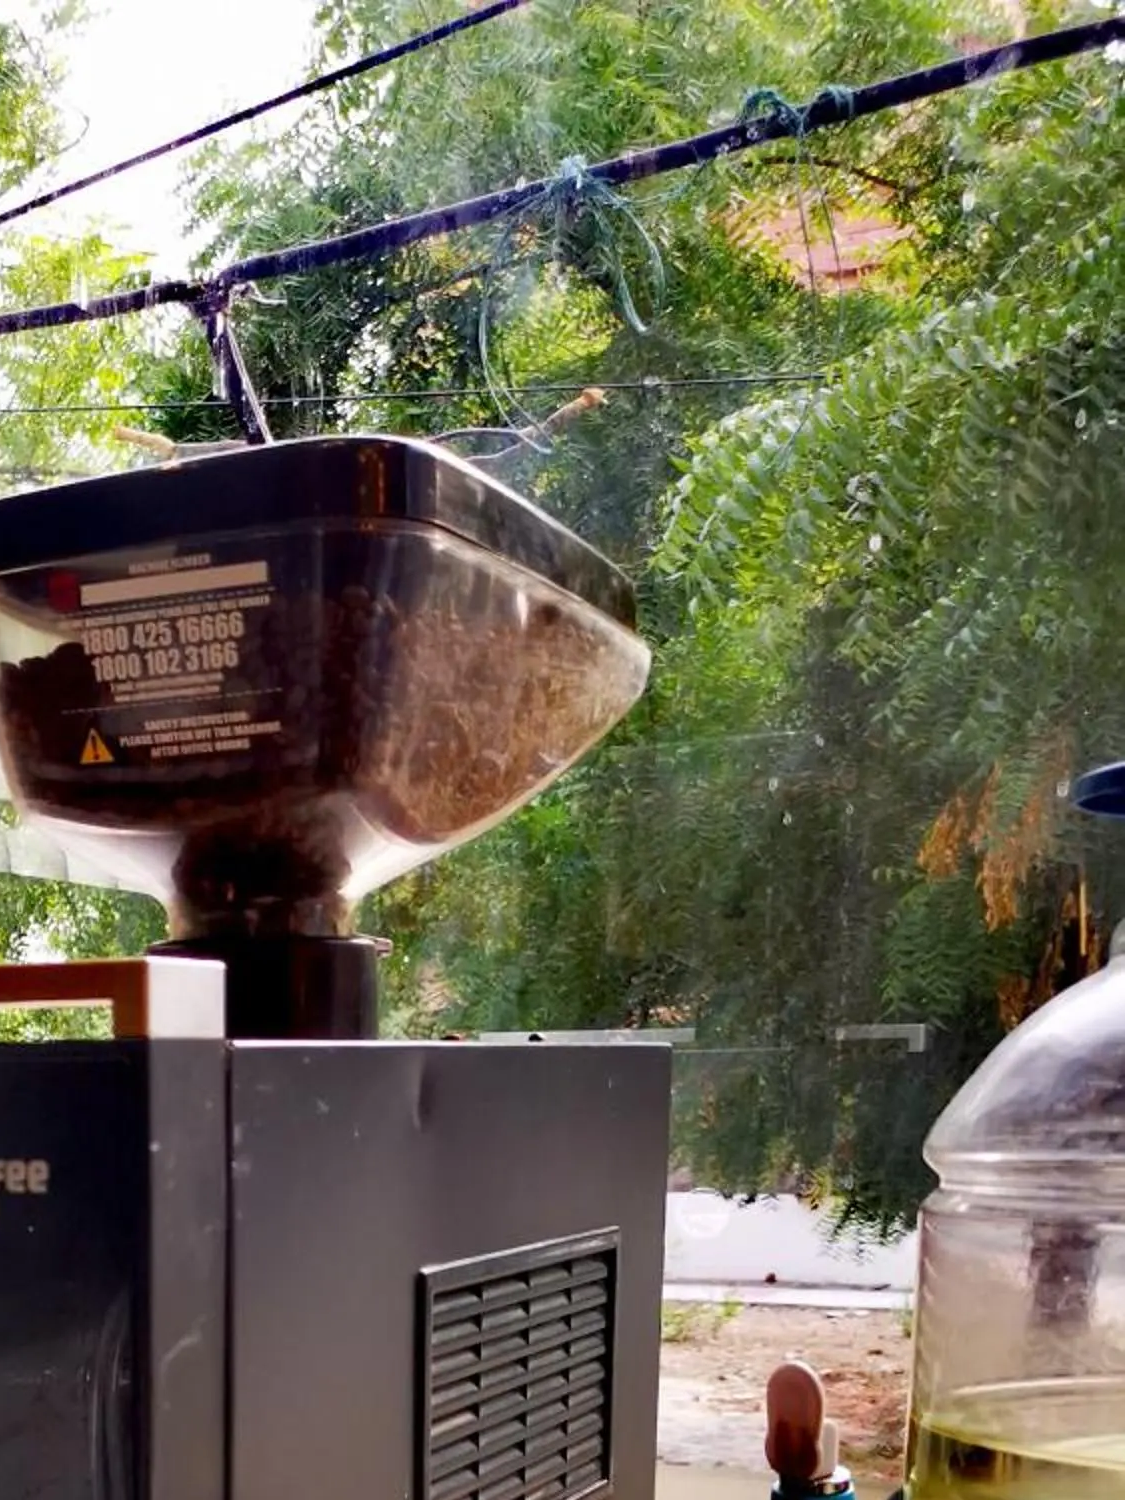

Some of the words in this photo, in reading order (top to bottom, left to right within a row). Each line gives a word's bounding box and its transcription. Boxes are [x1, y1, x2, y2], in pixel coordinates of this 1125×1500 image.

[81, 626, 129, 655] 1800
[133, 621, 173, 649] 425
[175, 611, 245, 645] 16666
[92, 652, 141, 682] 1800
[144, 648, 182, 675] 102
[185, 641, 239, 673] 3166
